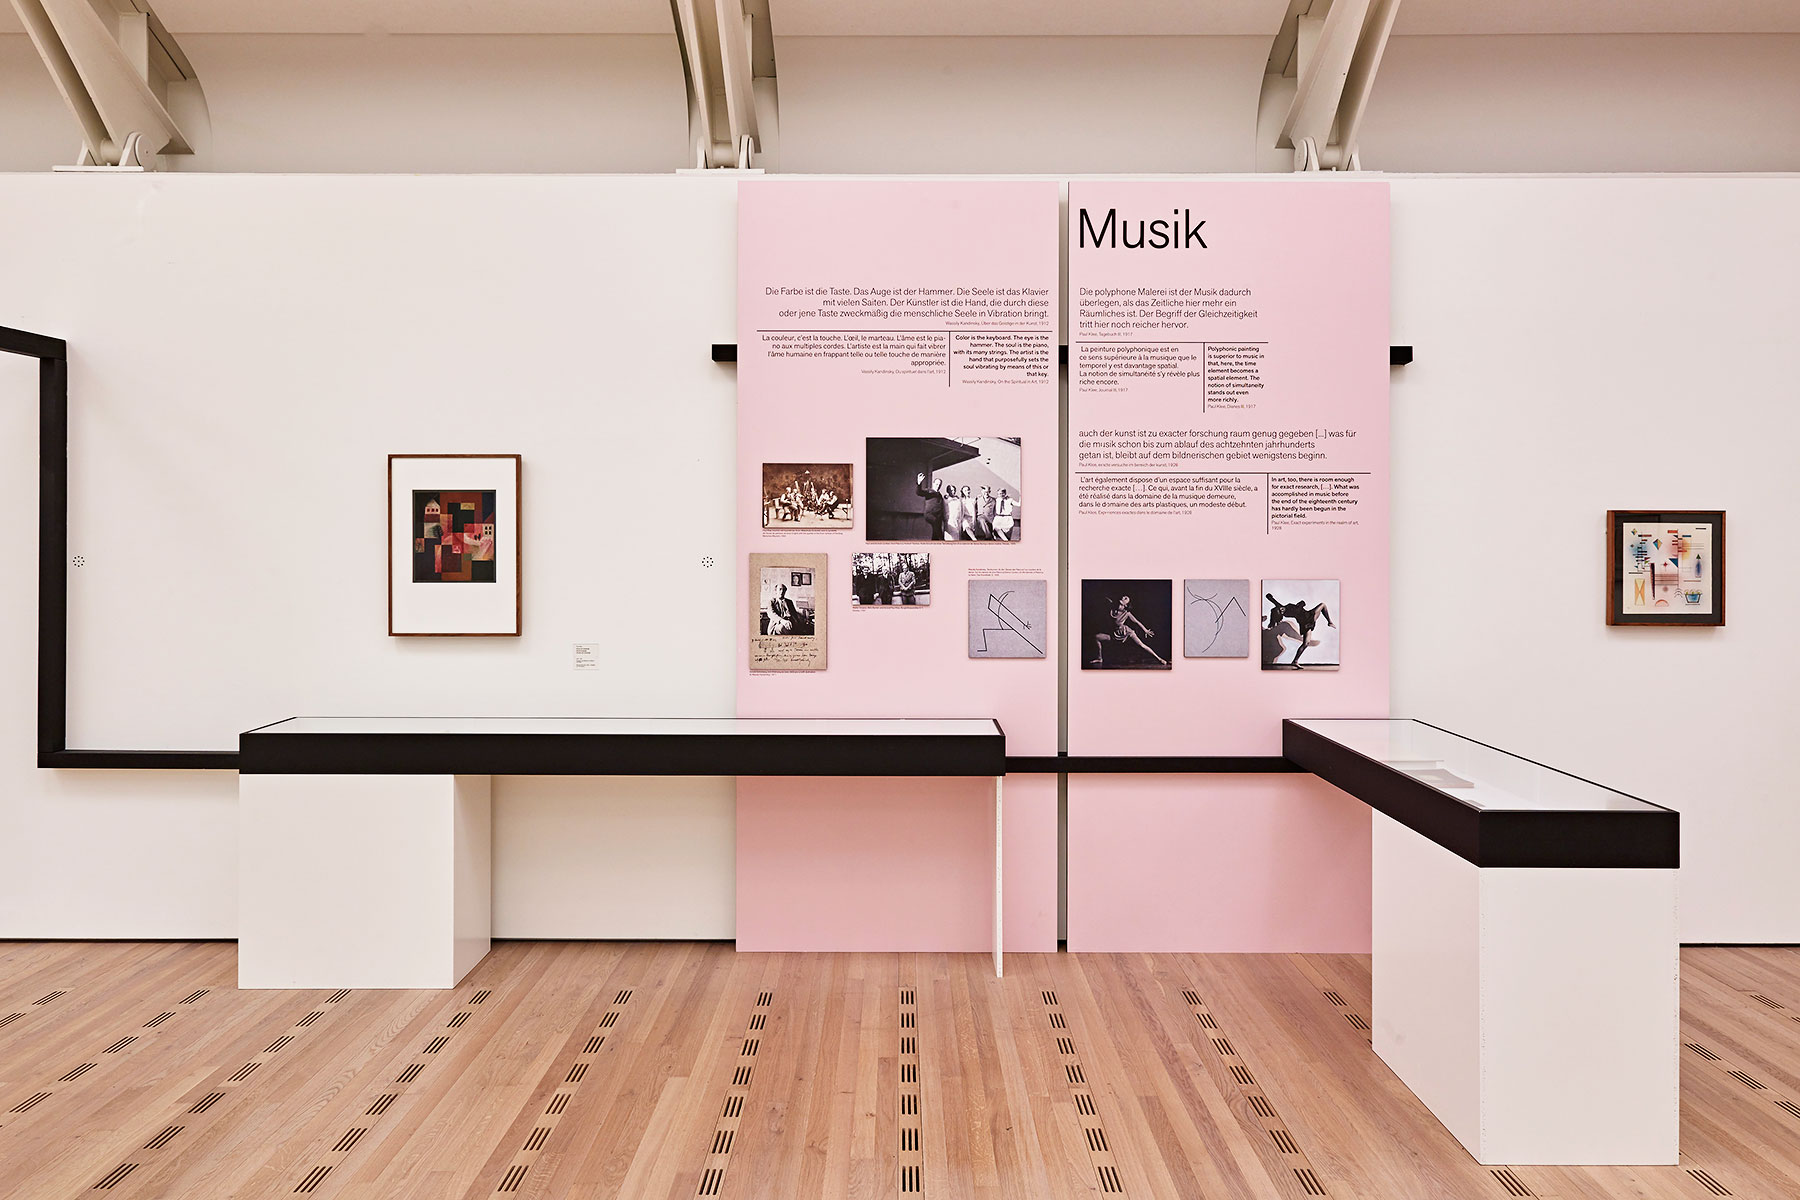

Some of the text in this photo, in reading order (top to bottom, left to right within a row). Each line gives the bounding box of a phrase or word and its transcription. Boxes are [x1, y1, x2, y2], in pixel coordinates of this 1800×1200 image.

[1080, 209, 1207, 249] Musik
[766, 287, 779, 295] Die
[781, 287, 803, 295] Farbe
[830, 287, 852, 295] Taste.
[854, 287, 869, 295] Das
[870, 288, 891, 297] Auge
[957, 287, 970, 296] Die
[972, 287, 994, 296] Seele
[996, 288, 1005, 296] ist
[1006, 288, 1020, 296] das
[1022, 288, 1049, 296] Klavier
[1080, 288, 1251, 297] Die polyphone Malerei ist der Musik dadurch
[823, 298, 835, 306] mit
[837, 298, 860, 306] vielen
[862, 298, 888, 306] Saiten.
[890, 298, 905, 306] Der
[1027, 299, 1049, 307] diese
[1123, 299, 1134, 307] als
[1135, 299, 1149, 307] das
[1151, 299, 1184, 307] Zeitliche
[1186, 299, 1200, 307] hier
[1202, 299, 1223, 307] mehr
[1225, 299, 1236, 307] ein
[779, 309, 797, 317] oder
[798, 309, 816, 319] jene
[818, 309, 838, 317] Taste
[890, 309, 902, 317] die
[904, 309, 953, 317] menschliche
[954, 309, 977, 317] Seele
[987, 309, 1022, 317] Vibration
[1024, 310, 1048, 319] bringt.
[1127, 309, 1137, 318] ist.
[1139, 309, 1154, 317] Der
[1156, 309, 1182, 319] Begriff
[1183, 310, 1197, 318] der
[1198, 309, 1257, 319] Gleichzeitigkeit
[1080, 320, 1093, 328] tritt
[1094, 320, 1110, 328] hier
[1132, 320, 1160, 328] reicher
[1079, 429, 1098, 437] auch
[1099, 429, 1113, 437] der
[1189, 429, 1228, 439] forschung
[1252, 431, 1277, 439] genug
[1278, 430, 1314, 439] gegeben
[1079, 440, 1091, 448] die
[1118, 440, 1141, 448] schon
[1143, 440, 1154, 448] bis
[1174, 440, 1198, 448] ablauf
[1200, 440, 1214, 448] des
[1216, 440, 1263, 448] achtzehnten
[1265, 440, 1315, 450] jahrhunderts
[1079, 452, 1101, 461] getan
[1115, 451, 1137, 459] bleibt
[1139, 451, 1151, 459] auf
[1153, 451, 1170, 459] dem
[1172, 451, 1224, 459] bildnerischen
[1226, 451, 1251, 461] gebiet
[1252, 451, 1297, 461] wenigstens
[1298, 451, 1327, 461] beginn.
